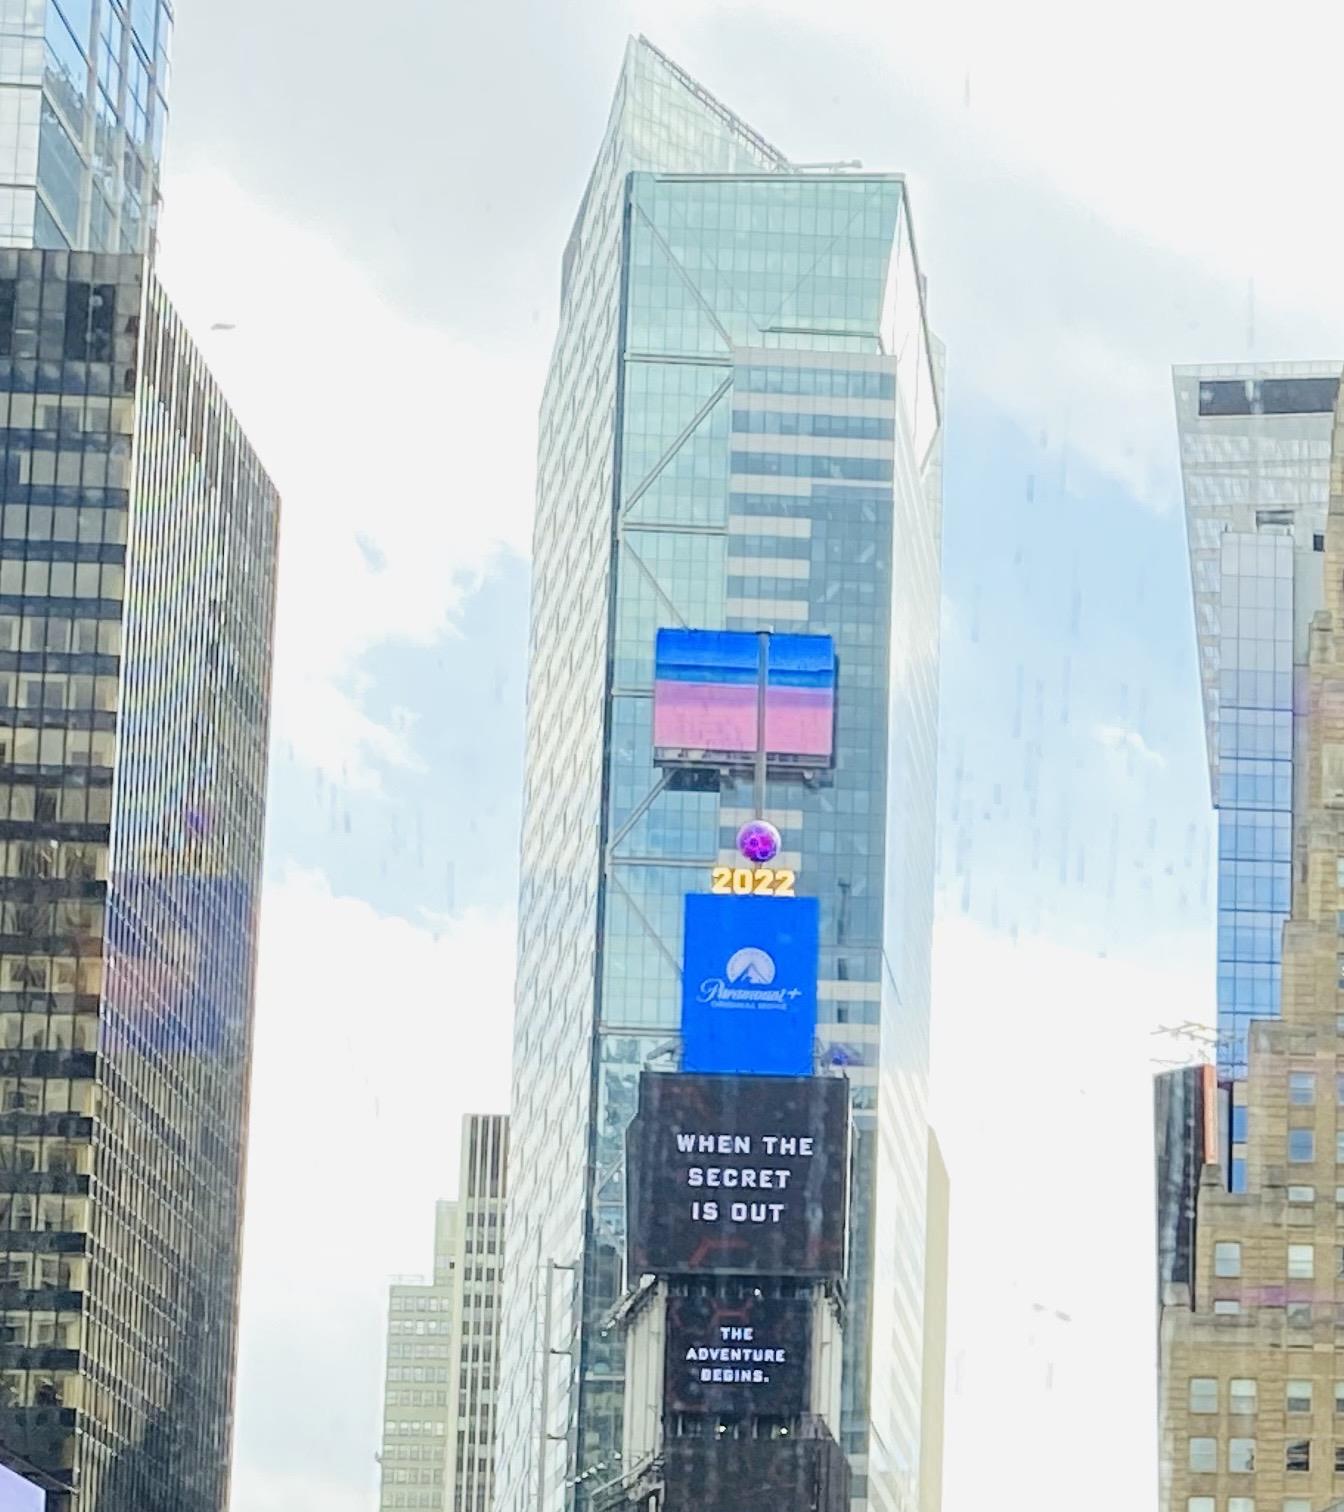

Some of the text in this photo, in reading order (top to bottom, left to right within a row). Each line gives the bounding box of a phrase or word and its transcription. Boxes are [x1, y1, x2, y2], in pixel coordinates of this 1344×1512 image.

[712, 867, 795, 897] 2022
[677, 1134, 814, 1156] WHEN THE
[688, 1168, 791, 1188] SECRET
[692, 1202, 785, 1222] IS OUT
[720, 1327, 753, 1340] THE
[686, 1348, 786, 1362] ADVENTURE
[700, 1369, 769, 1383] BEGINS.
